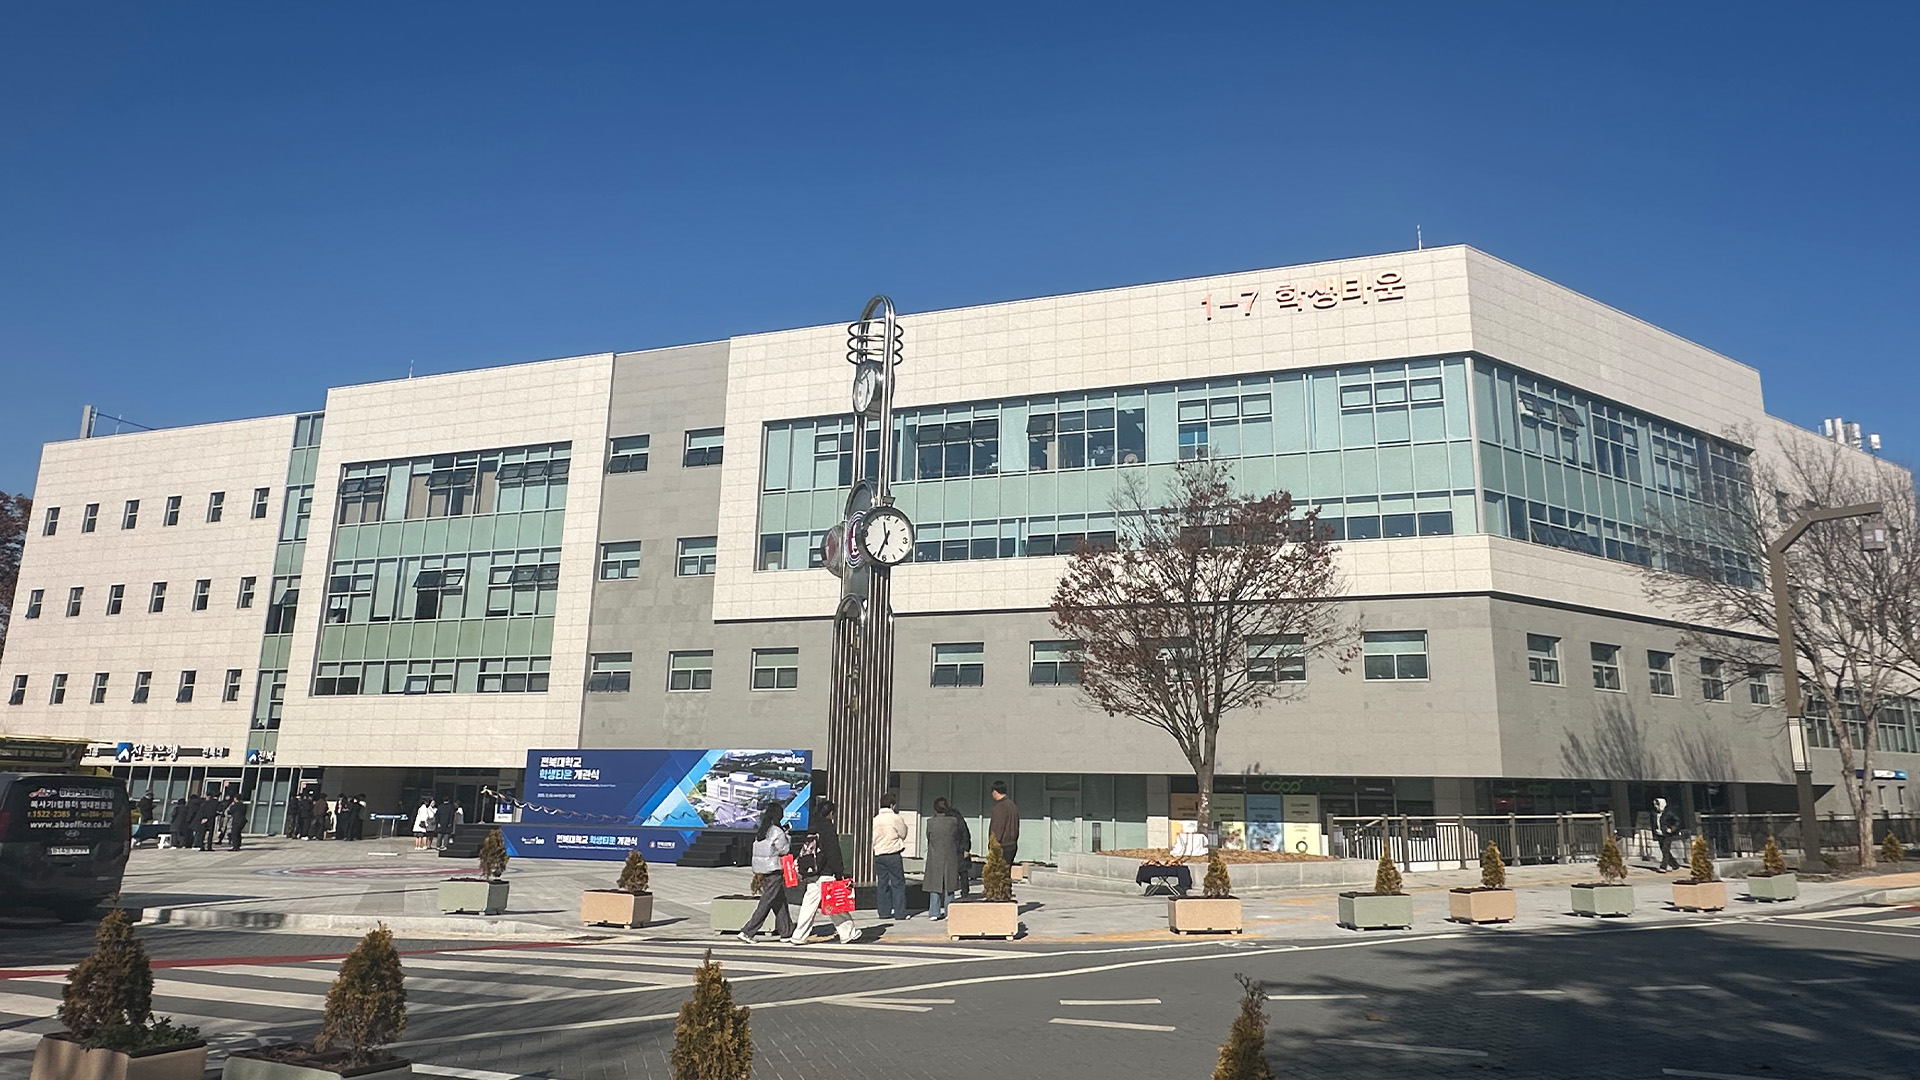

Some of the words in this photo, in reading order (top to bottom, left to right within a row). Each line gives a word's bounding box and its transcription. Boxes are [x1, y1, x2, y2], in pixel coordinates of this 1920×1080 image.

[1201, 289, 1259, 321] 1-7
[1276, 271, 1406, 312] 학생타운
[131, 744, 179, 761] 전북은행
[258, 750, 275, 764] 전북
[540, 756, 582, 768] 전북대학교
[539, 769, 572, 780] 학생타운
[574, 769, 600, 780] 개관식
[556, 834, 588, 845] 전북대학교
[589, 836, 616, 846] 학생타운
[617, 837, 638, 846] 개관식
